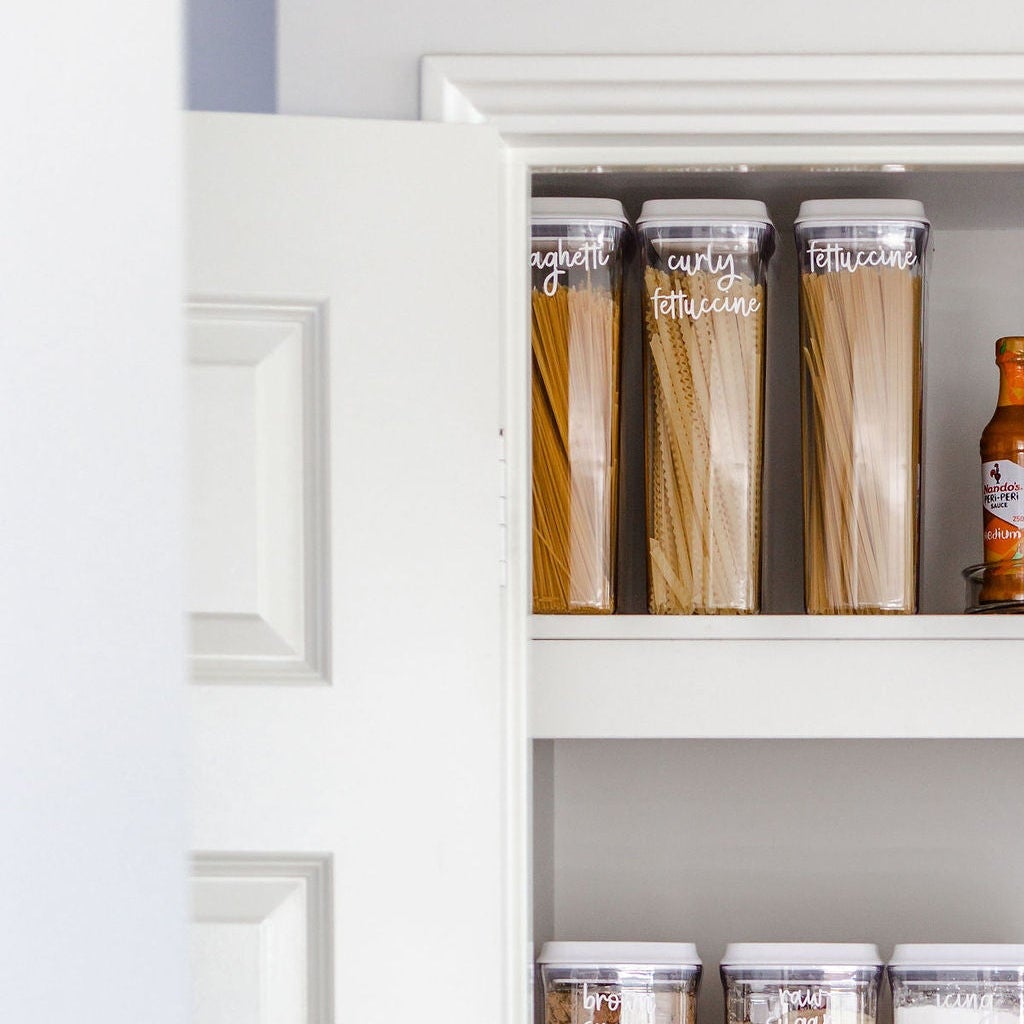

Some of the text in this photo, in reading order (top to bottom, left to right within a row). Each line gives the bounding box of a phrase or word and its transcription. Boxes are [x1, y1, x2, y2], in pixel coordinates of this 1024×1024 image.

[668, 244, 743, 291] curly
[806, 240, 917, 272] fettuccine
[650, 288, 761, 321] fettuccine
[778, 988, 832, 1011] raw
